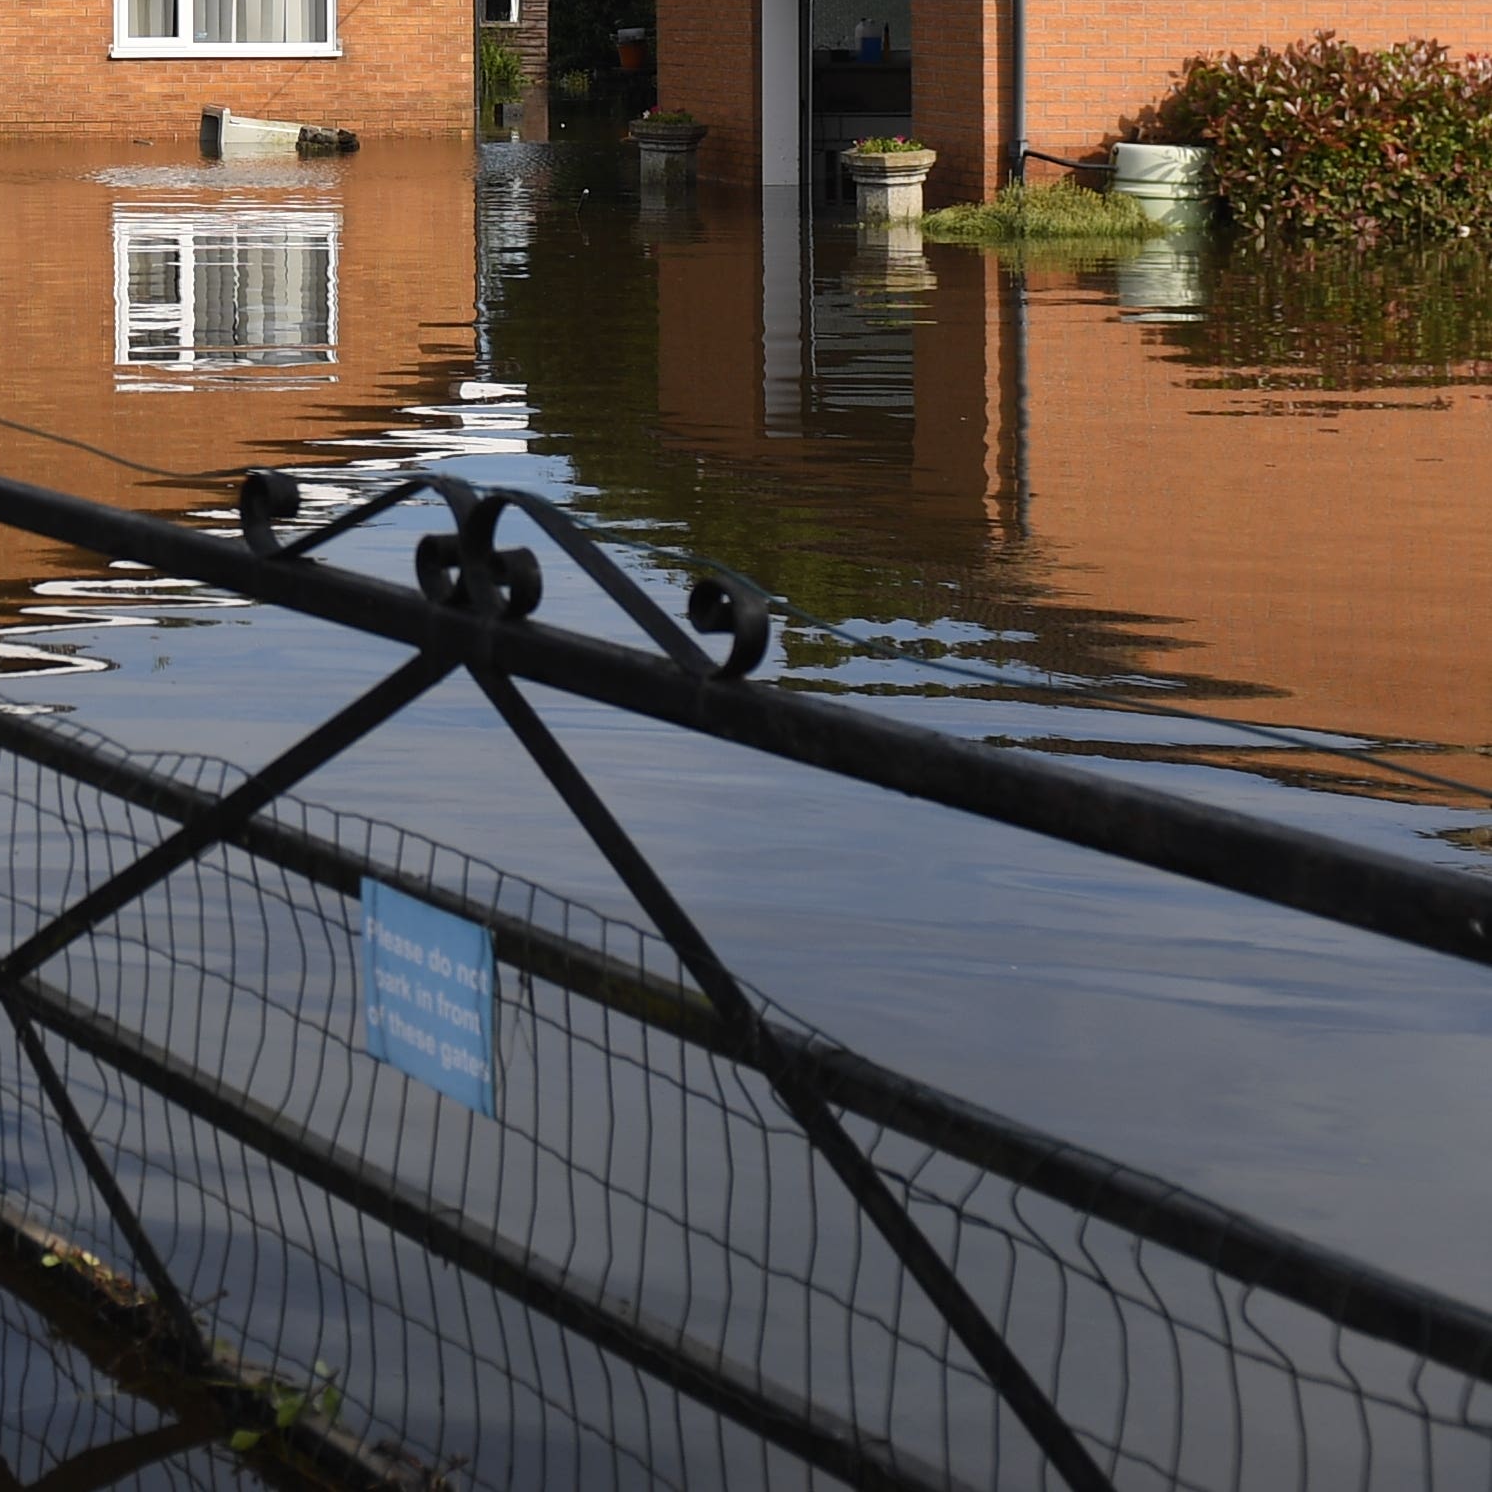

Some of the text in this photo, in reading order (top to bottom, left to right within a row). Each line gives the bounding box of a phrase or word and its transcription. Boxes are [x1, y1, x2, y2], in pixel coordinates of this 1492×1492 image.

[366, 916, 489, 996] Please do not
[367, 1004, 491, 1084] of these gates
[415, 981, 434, 1014] in
[436, 990, 482, 1037] front
